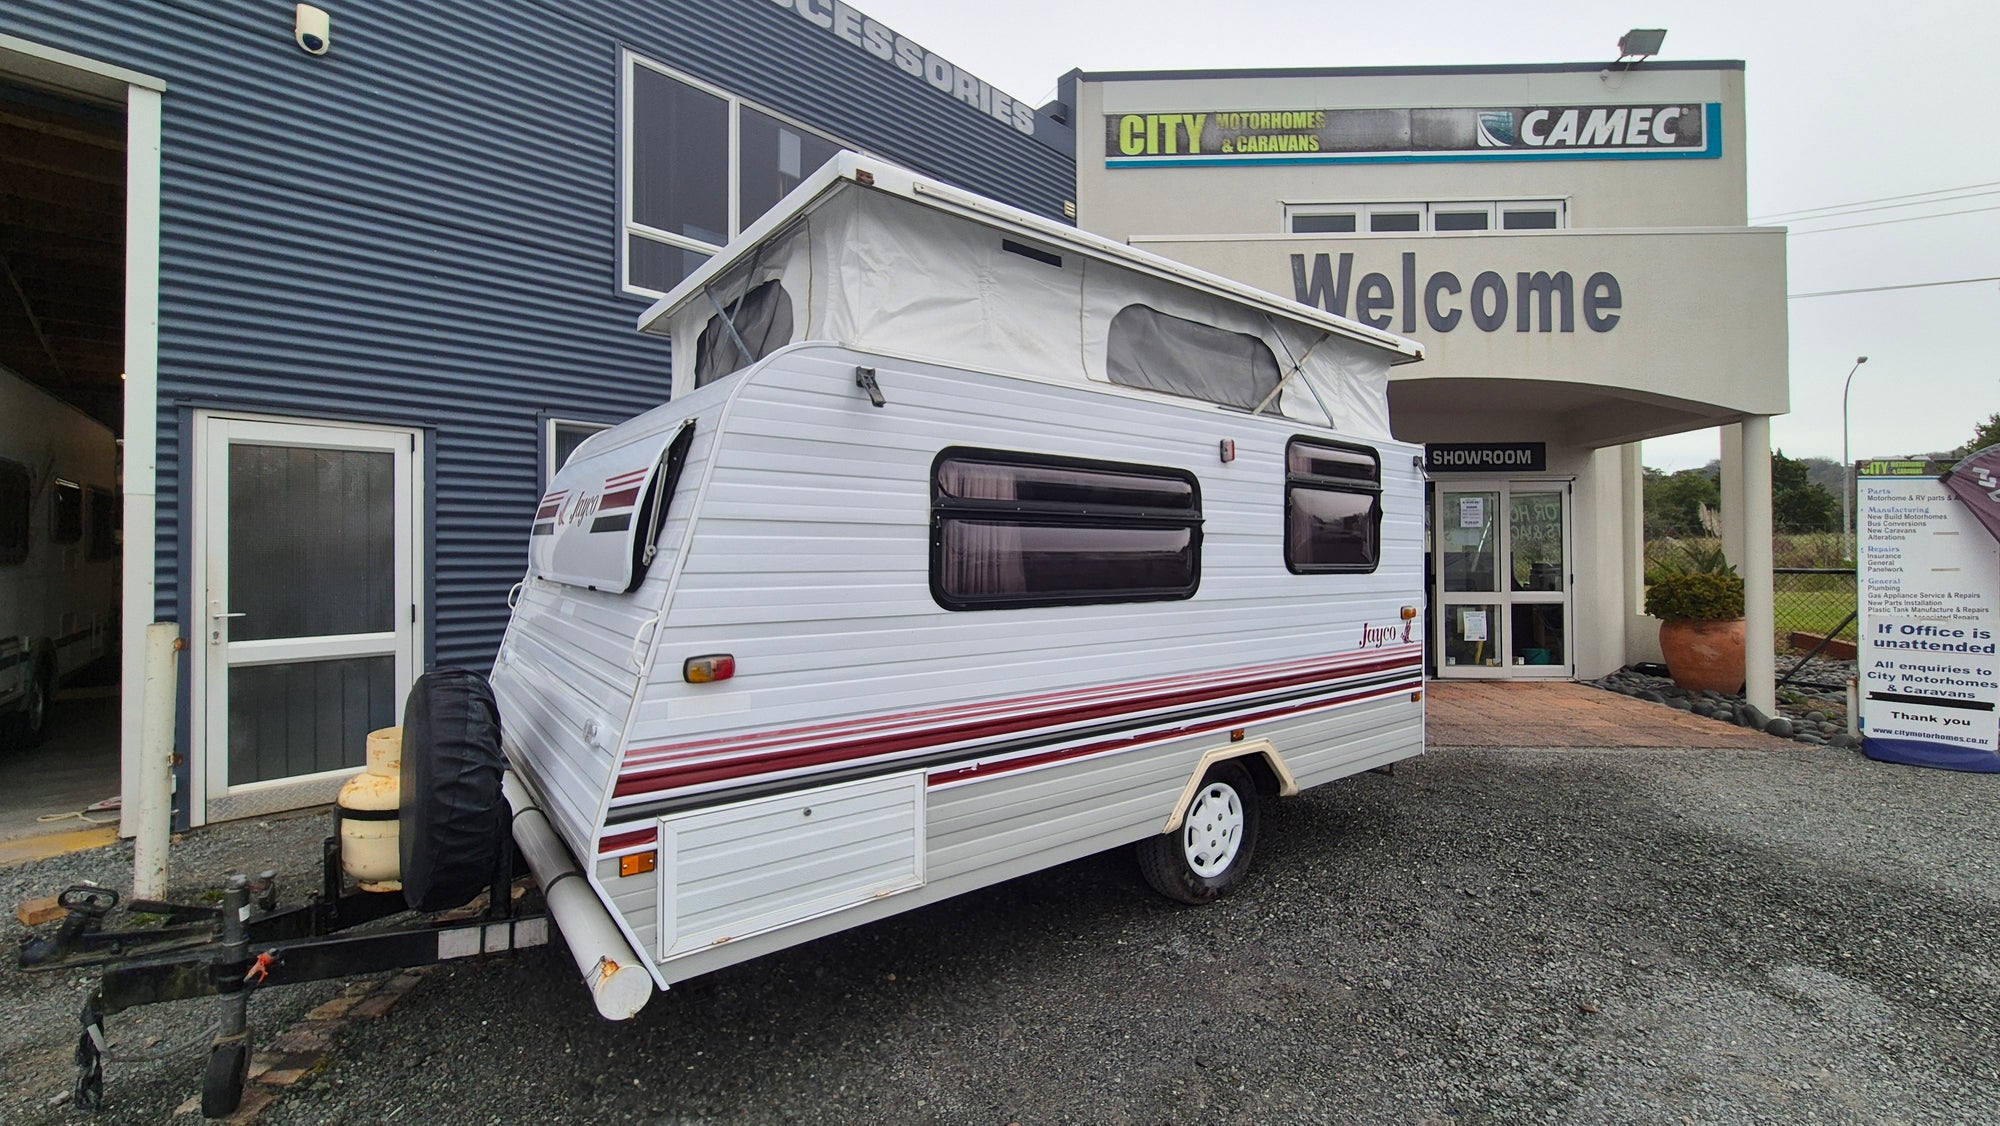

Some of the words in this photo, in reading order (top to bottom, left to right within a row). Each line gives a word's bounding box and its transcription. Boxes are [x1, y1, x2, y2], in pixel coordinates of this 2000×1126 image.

[773, 0, 1035, 136] CESSORIES
[1215, 111, 1326, 130] MOTORHOMES
[1520, 106, 1680, 146] CAMEC
[1119, 114, 1207, 155] CITY
[1222, 138, 1234, 153] &
[1236, 134, 1320, 152] CARAVANS
[1290, 252, 1622, 333] Welcome
[1432, 450, 1531, 465] SHOWROOM
[569, 490, 600, 527] Jayco
[1359, 622, 1396, 649] Jayco
[1878, 624, 1893, 634] If
[1900, 624, 1965, 638] Office
[1973, 628, 1991, 640] is
[1874, 639, 1996, 654] unattended
[1874, 660, 1894, 669] All
[1899, 663, 1970, 676] enquiries
[1976, 668, 1992, 676] to
[1867, 672, 1896, 682] City
[1902, 674, 1998, 689] Motorhomes
[1887, 684, 1897, 692] &
[1904, 686, 1976, 699] Caravans
[1890, 711, 1938, 723] Thank
[1943, 718, 1971, 726] you
[1872, 727, 1988, 745] www.citymotorhomes.co.nz
